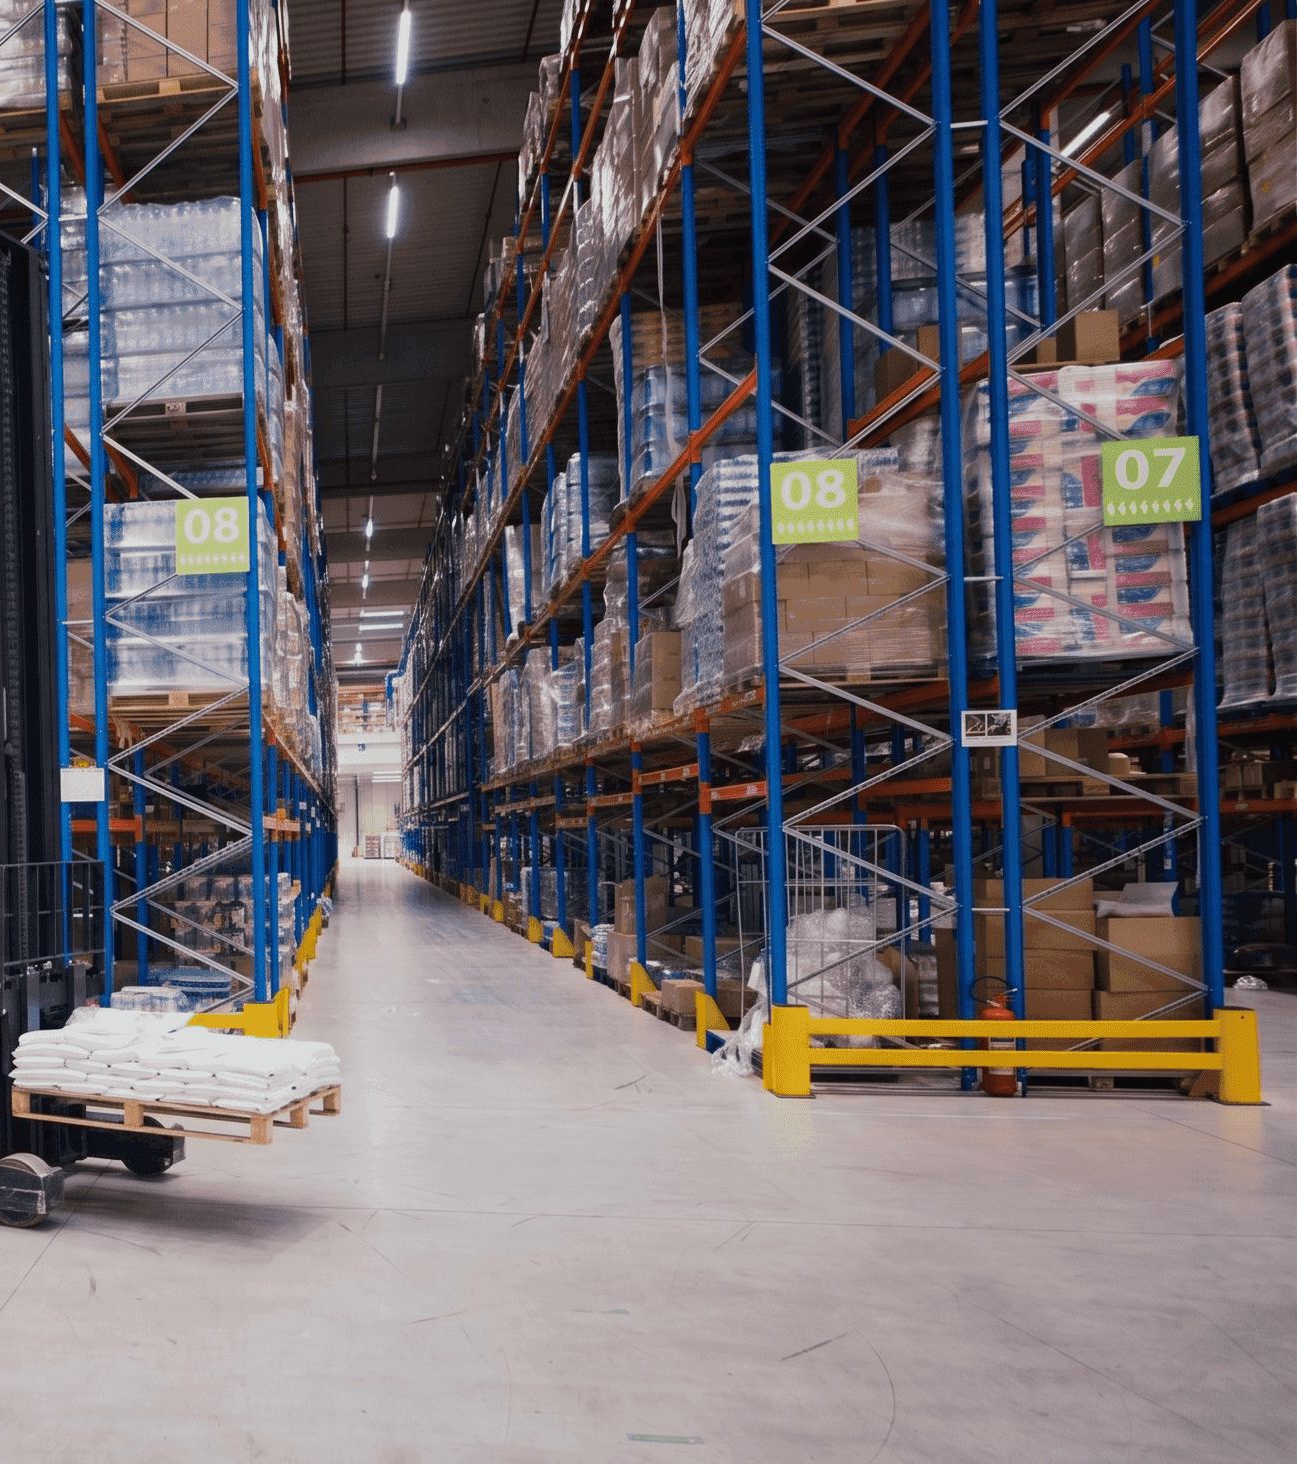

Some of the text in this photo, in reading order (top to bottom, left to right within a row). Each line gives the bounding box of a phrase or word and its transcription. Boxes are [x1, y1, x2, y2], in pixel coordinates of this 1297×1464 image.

[1115, 447, 1186, 490] 07
[781, 469, 846, 510] 08
[184, 507, 241, 544] 08
